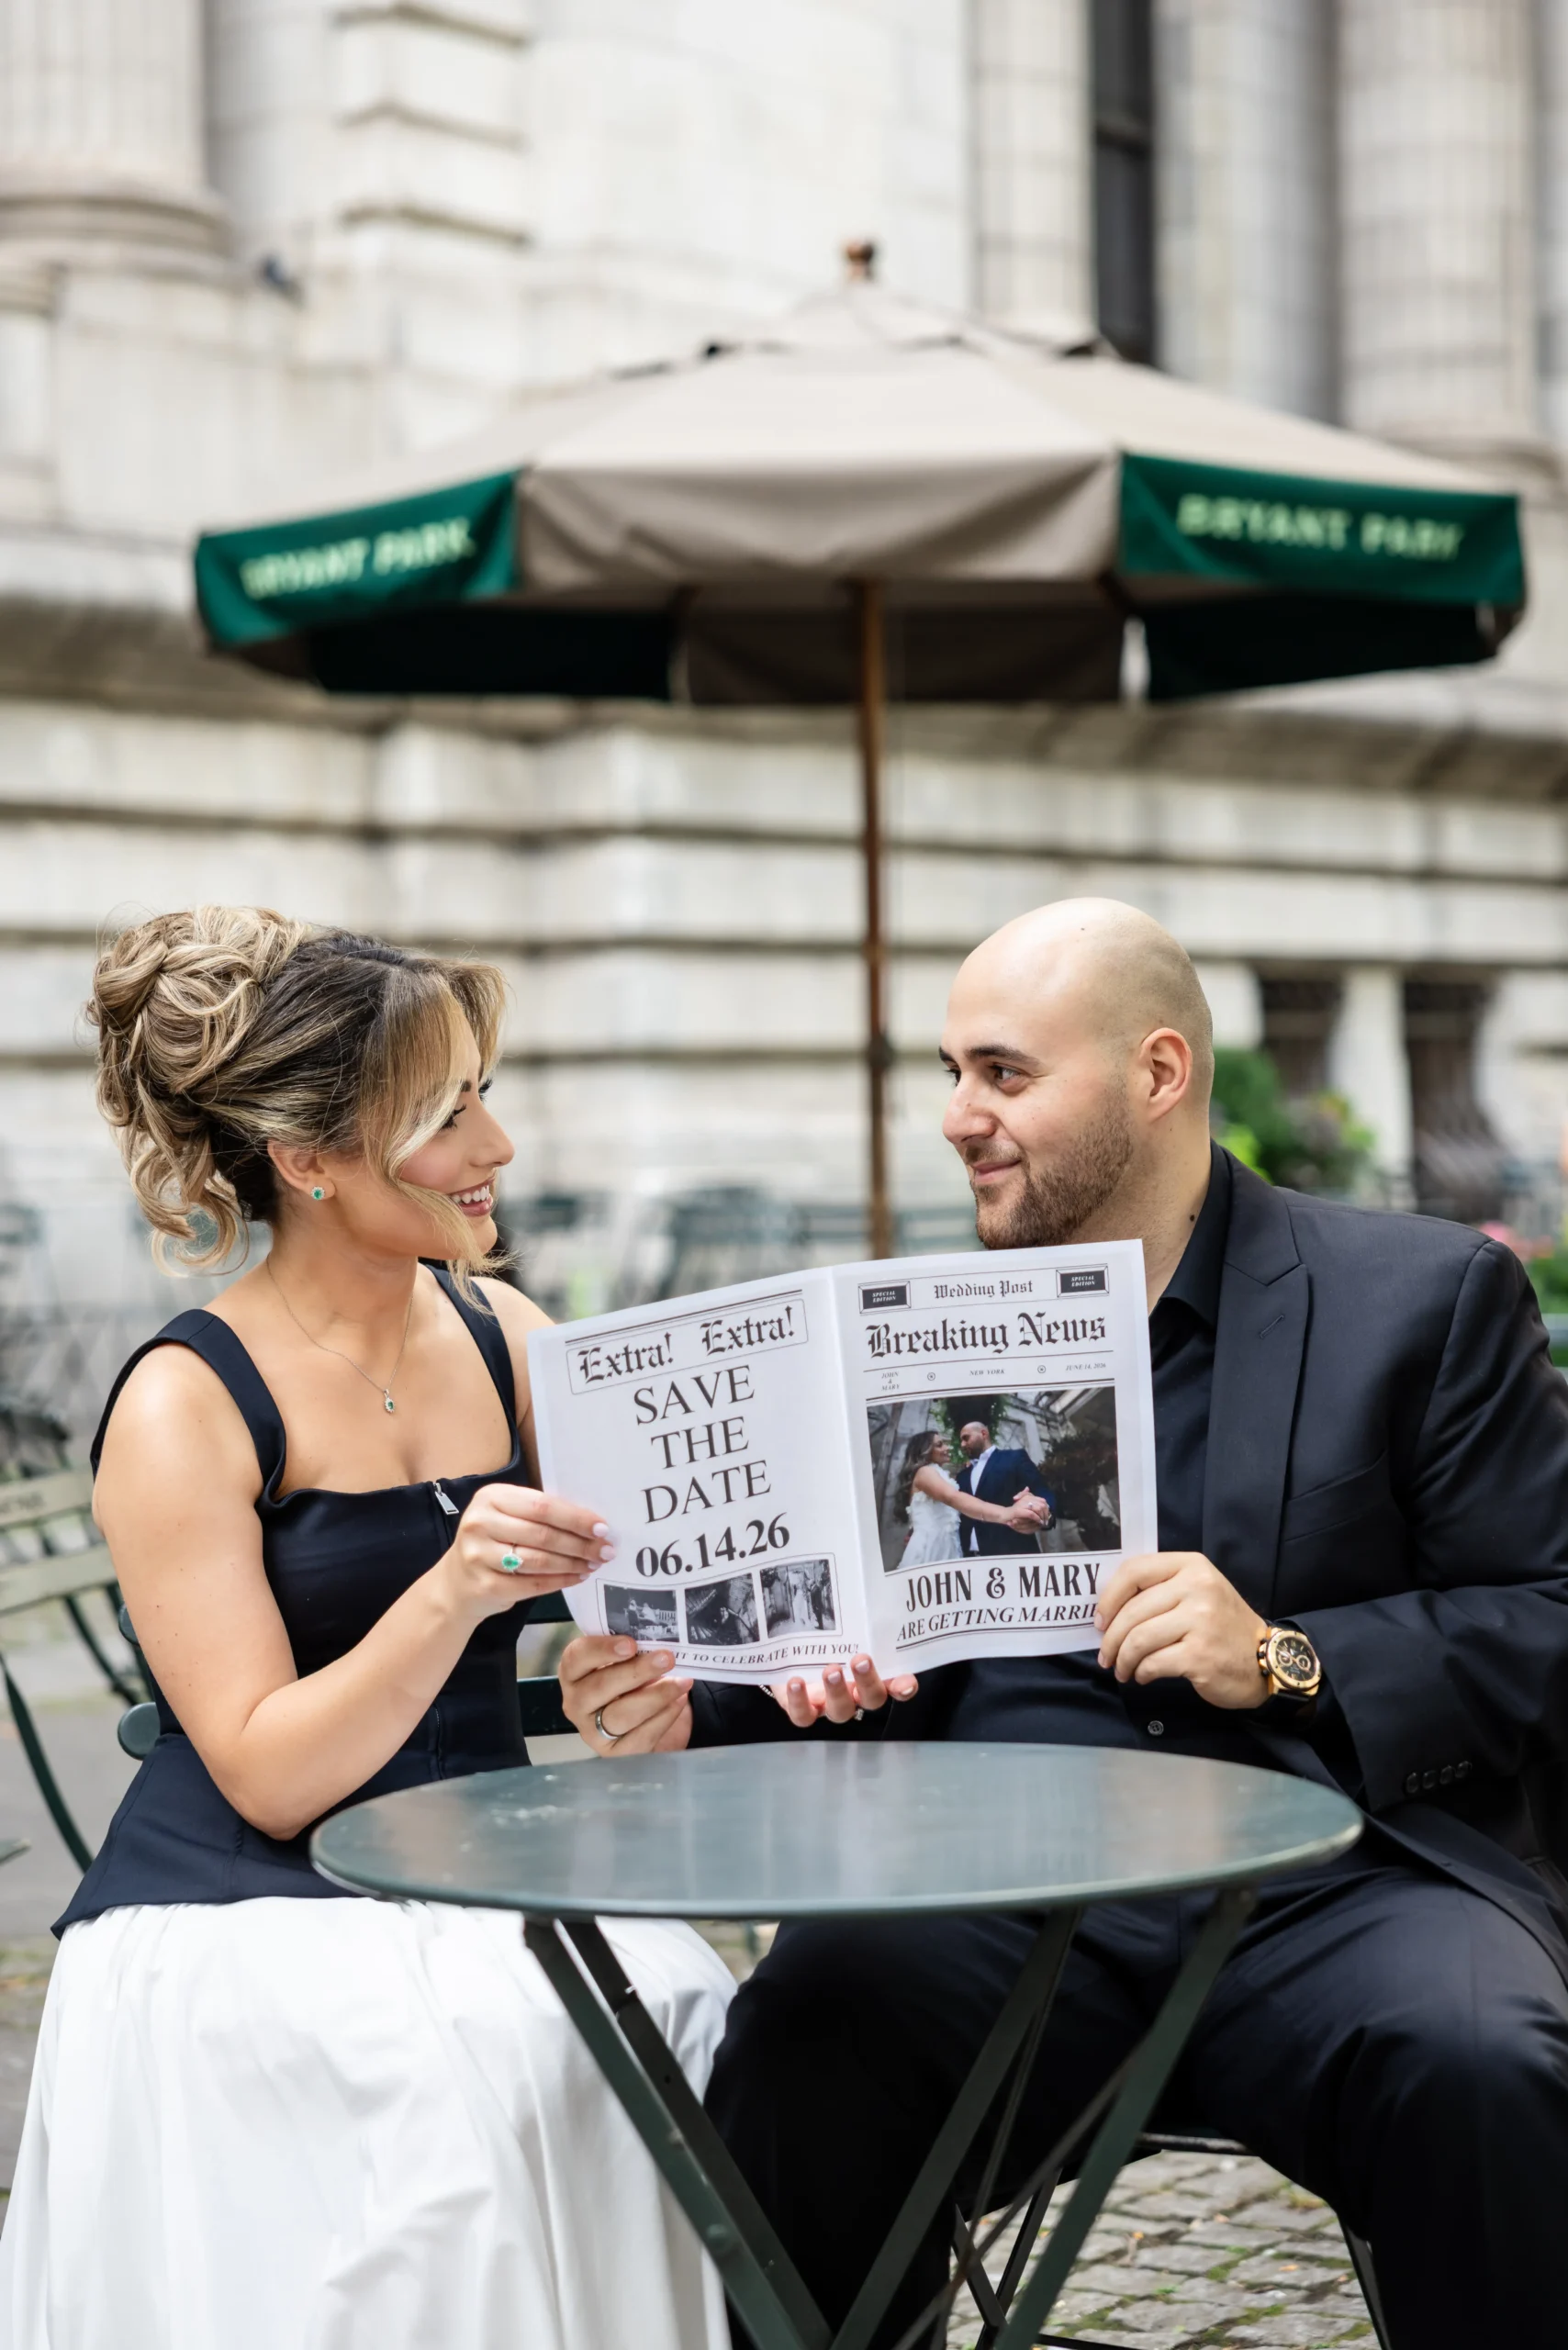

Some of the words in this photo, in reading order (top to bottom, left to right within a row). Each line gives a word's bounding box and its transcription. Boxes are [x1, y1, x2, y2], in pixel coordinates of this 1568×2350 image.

[1177, 493, 1352, 550] BRYANT
[934, 1283, 995, 1299] Wedding
[1000, 1280, 1033, 1297] Post
[577, 1331, 675, 1384] Extra!
[700, 1304, 795, 1357] Extra!
[866, 1317, 1009, 1359] Breaking
[1017, 1311, 1106, 1347] News
[633, 1364, 756, 1426] SAVE
[651, 1416, 749, 1469] THE
[641, 1460, 771, 1524] DATE
[635, 1512, 790, 1577] 06.14.26
[906, 1569, 972, 1612] JOHN
[986, 1567, 1005, 1599] &
[1018, 1563, 1100, 1598] MARY
[897, 1618, 925, 1641] ARE
[928, 1607, 1014, 1631] GETTING
[692, 1653, 709, 1662] TO
[712, 1647, 789, 1663] CELEBRATE
[792, 1644, 827, 1656] WITH
[831, 1643, 859, 1654] YOU!
